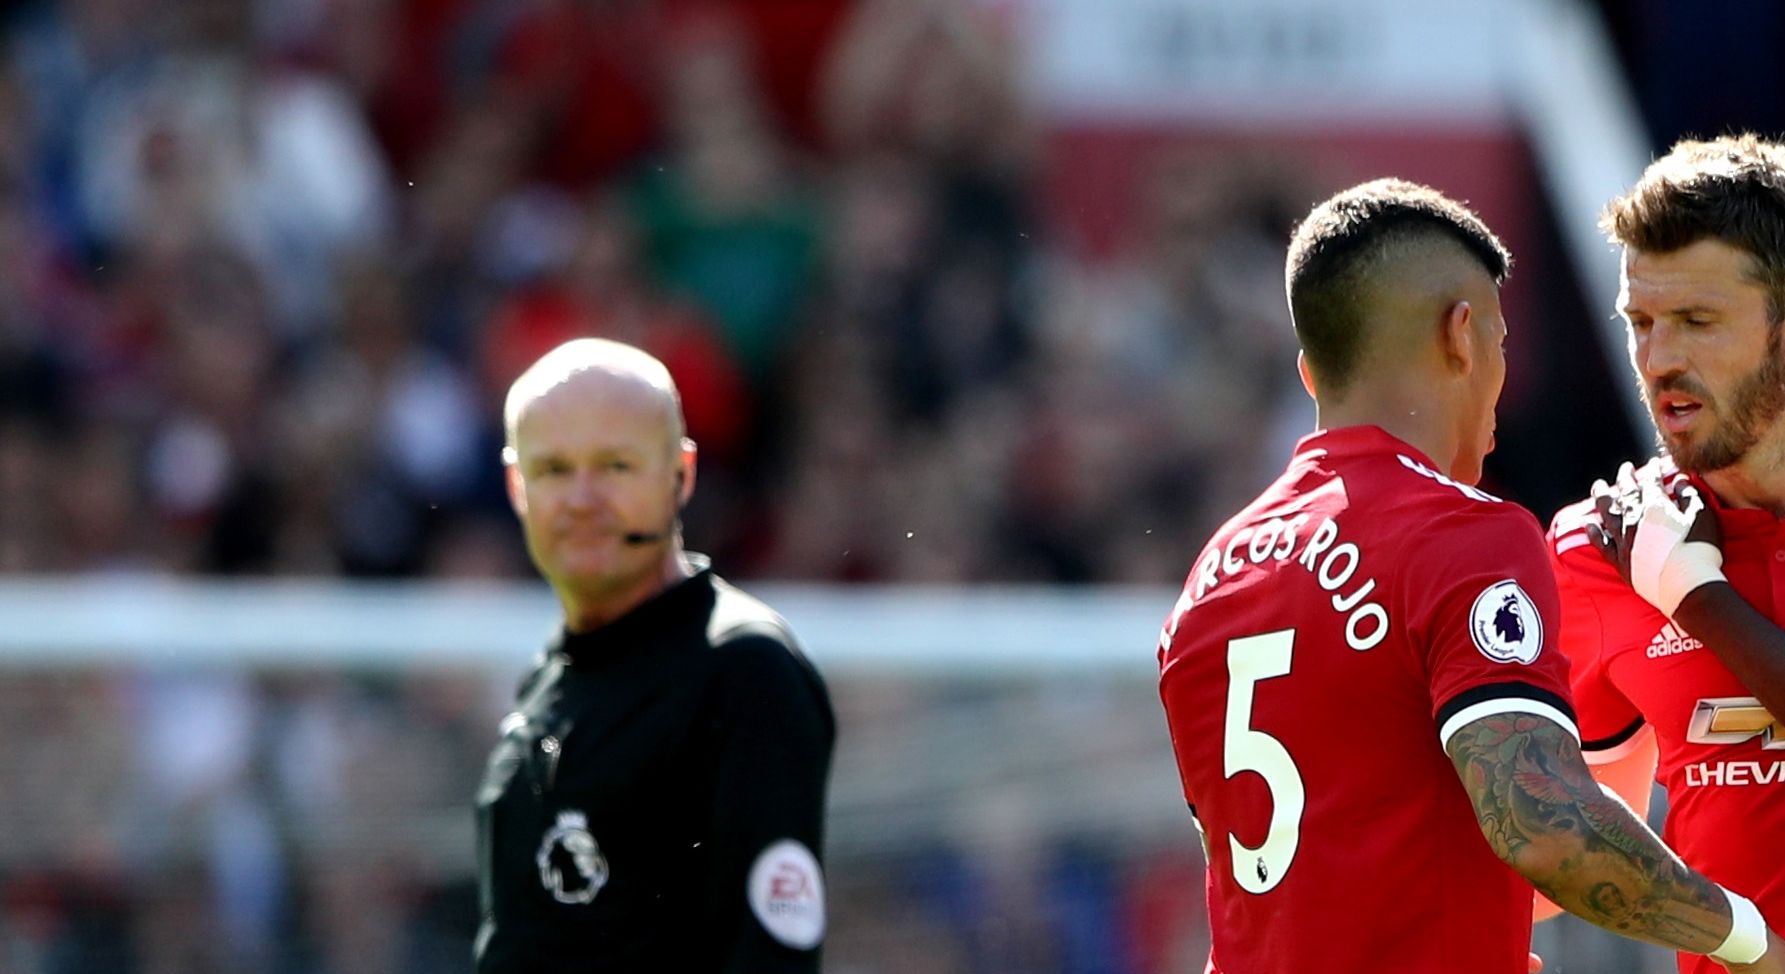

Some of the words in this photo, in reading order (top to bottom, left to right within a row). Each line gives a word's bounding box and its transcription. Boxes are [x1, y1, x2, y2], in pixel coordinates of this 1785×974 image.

[1159, 511, 1310, 651] RCOS
[1298, 516, 1389, 651] ROJO
[1646, 637, 1704, 659] adidas
[1224, 628, 1305, 894] 5
